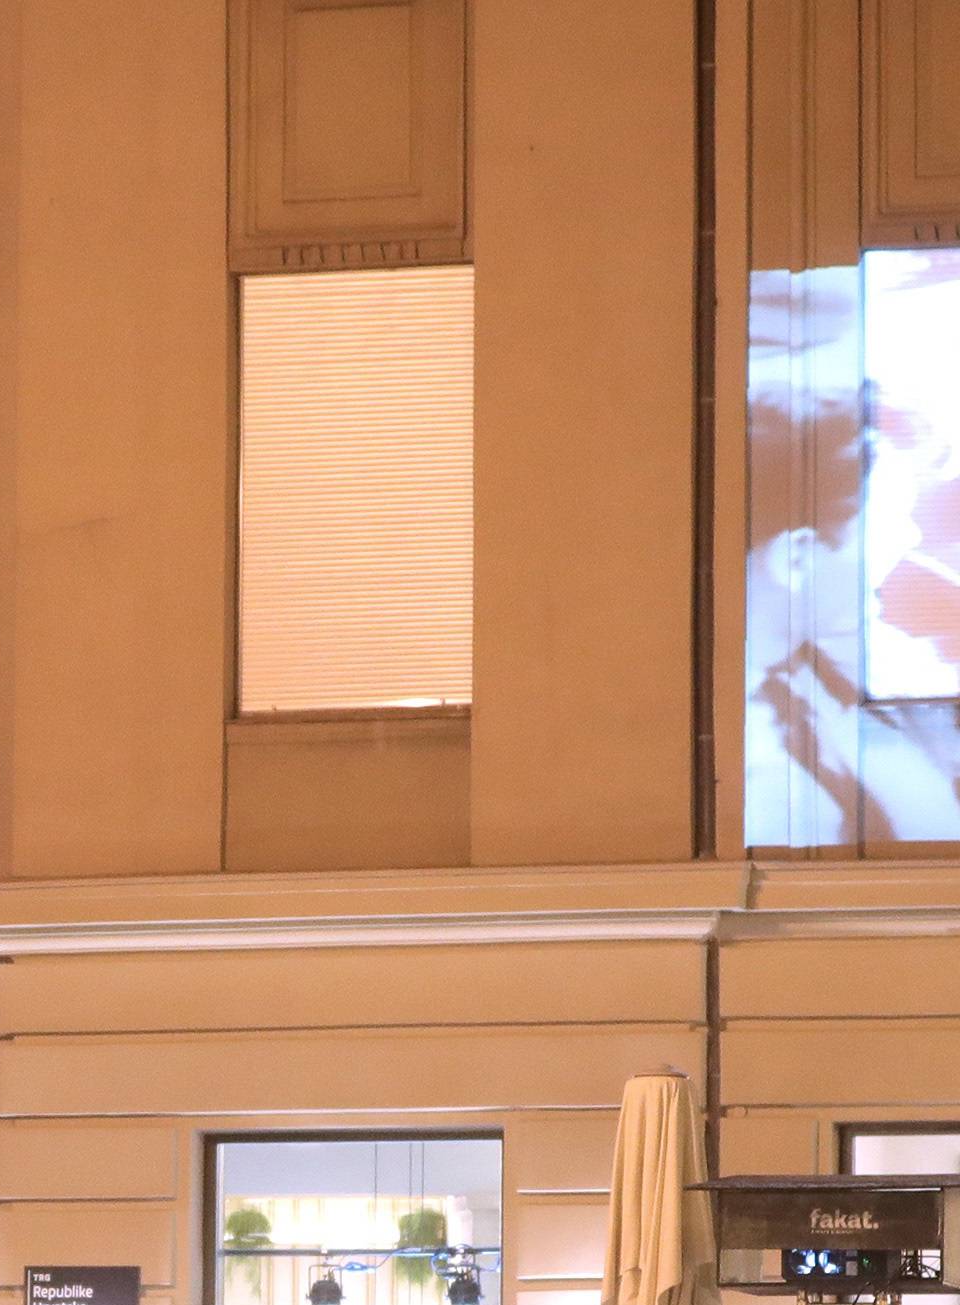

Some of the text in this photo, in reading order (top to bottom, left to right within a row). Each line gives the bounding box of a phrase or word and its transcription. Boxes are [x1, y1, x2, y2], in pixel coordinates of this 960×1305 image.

[809, 1208, 879, 1230] fakat.
[33, 1273, 51, 1282] TRG
[33, 1284, 94, 1301] Republike
